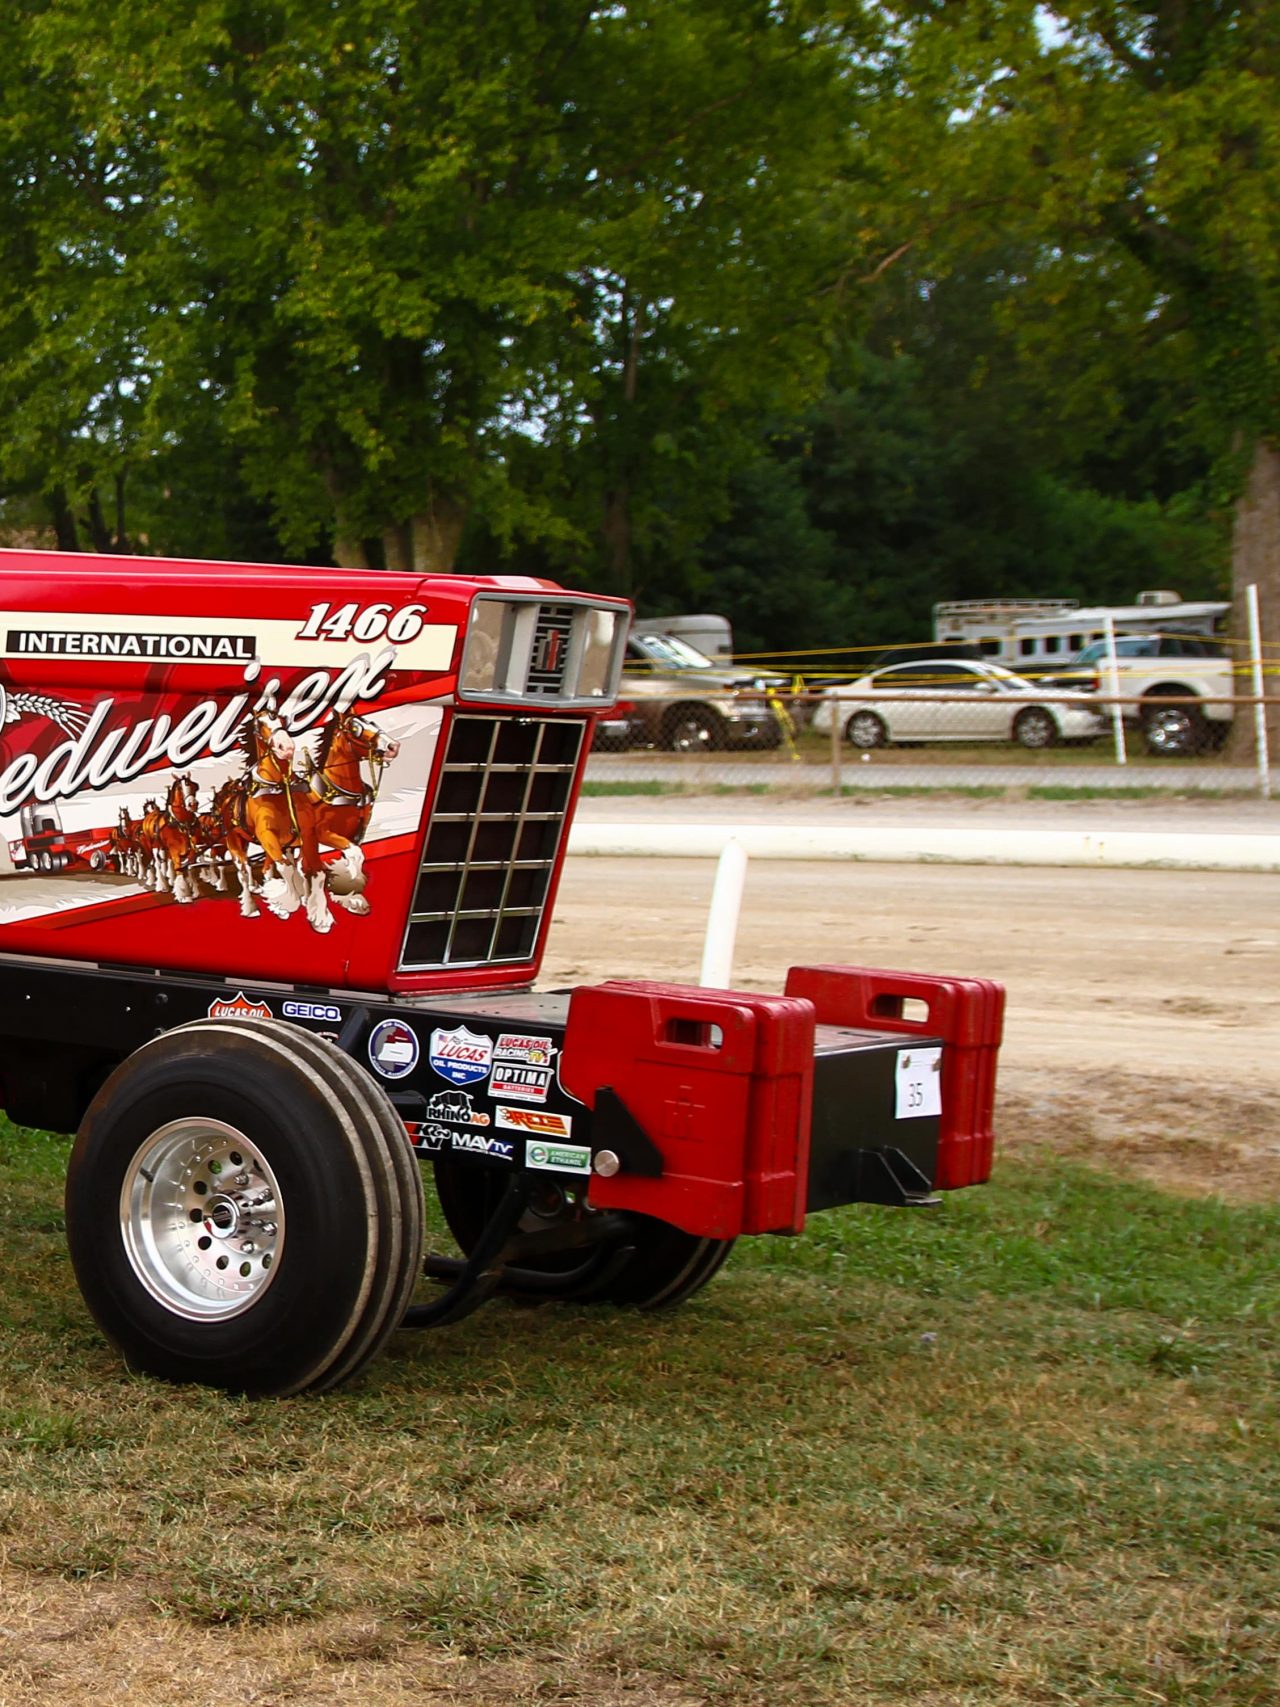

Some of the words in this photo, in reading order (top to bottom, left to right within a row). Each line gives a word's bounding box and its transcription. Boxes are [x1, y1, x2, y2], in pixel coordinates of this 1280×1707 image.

[296, 602, 428, 643] 1466
[19, 632, 252, 658] INTERNATIONAL
[214, 1005, 248, 1017] LUCAS
[284, 1003, 339, 1020] GEICO
[437, 1043, 488, 1062] LUCAS
[499, 1037, 532, 1049] LUCAS
[533, 1040, 550, 1050] OIL
[433, 1059, 446, 1068] OIL
[447, 1061, 488, 1074] PRODUCTS
[452, 1071, 466, 1080] INC
[495, 1067, 546, 1086] OPTIMA
[908, 1082, 923, 1107] 35
